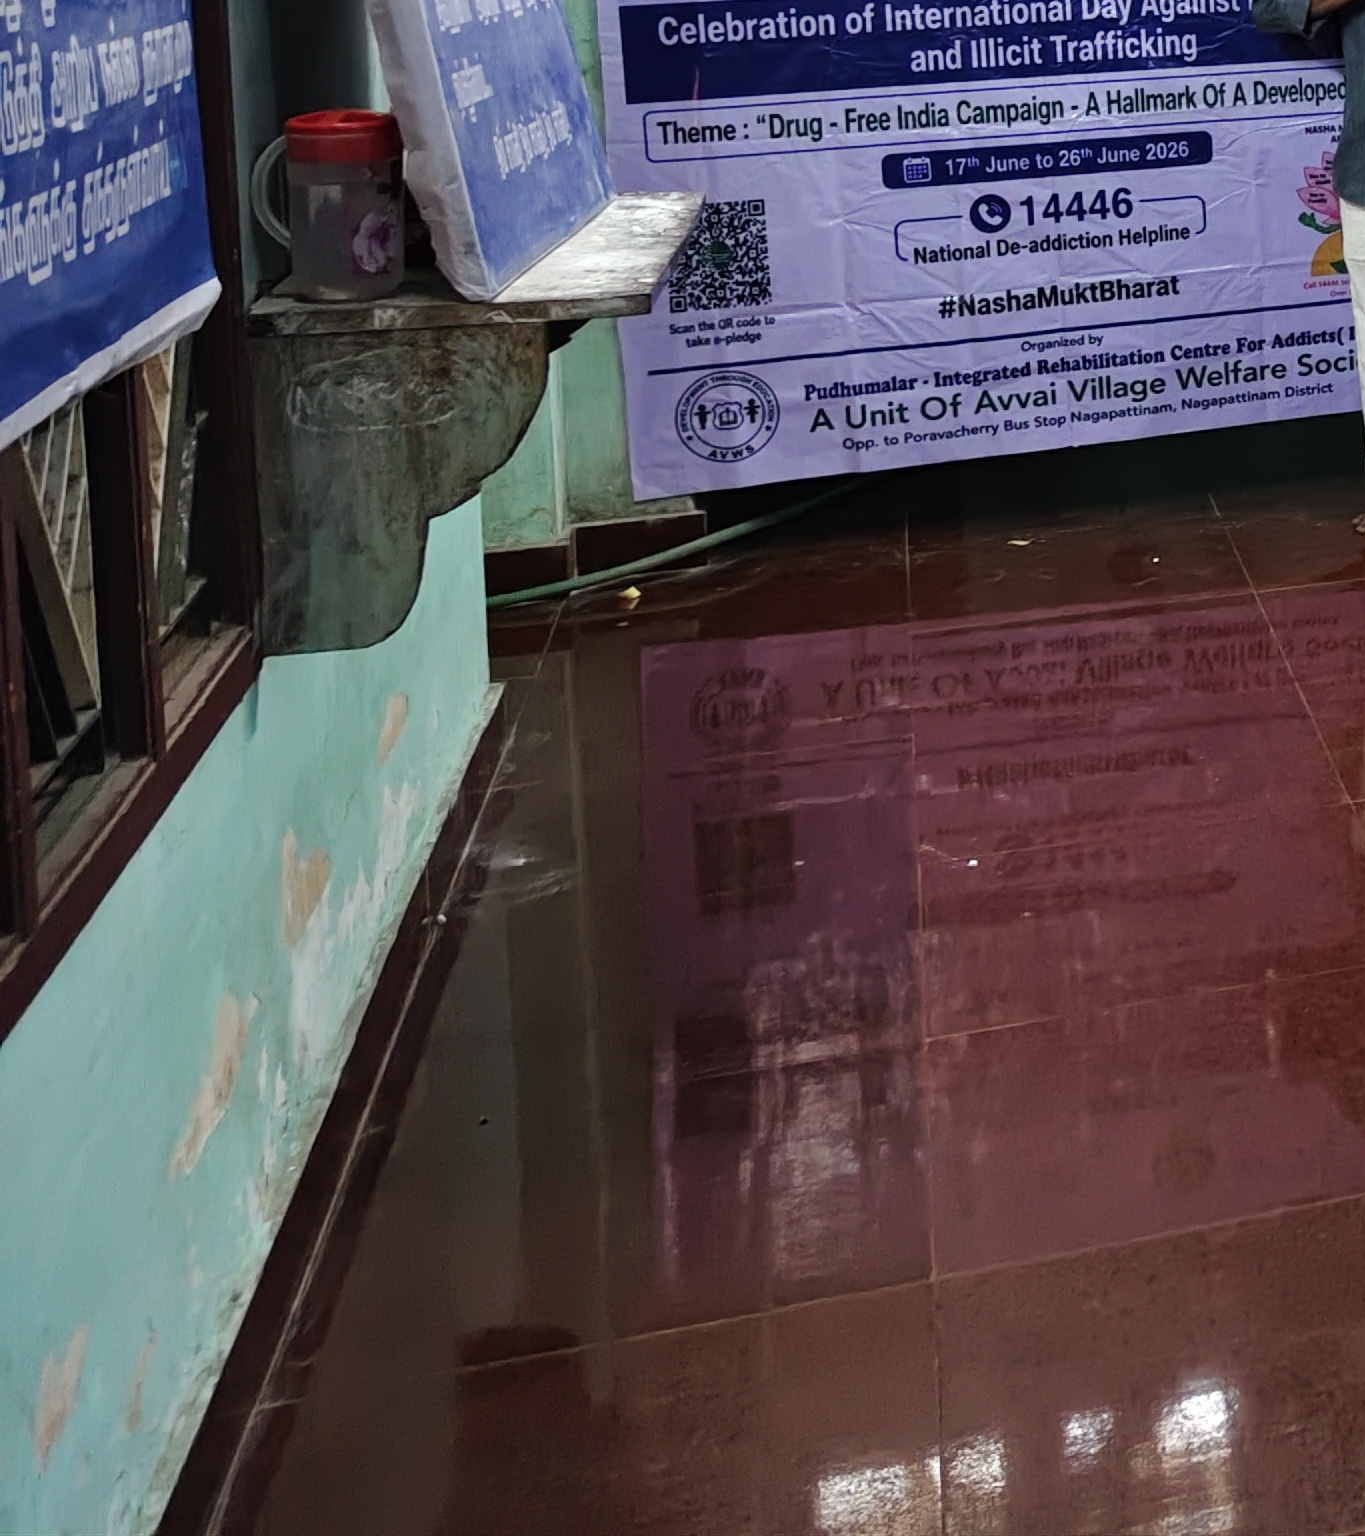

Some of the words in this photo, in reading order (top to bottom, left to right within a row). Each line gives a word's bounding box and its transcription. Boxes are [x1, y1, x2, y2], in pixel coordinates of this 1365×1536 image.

[657, 7, 836, 46] Celebration
[845, 2, 875, 34] of
[910, 39, 962, 73] and
[971, 35, 1042, 69] Illicit
[1050, 28, 1198, 64] Trafficking
[656, 119, 737, 145] Theme
[844, 107, 891, 134] Free
[897, 102, 949, 131] India
[956, 94, 1065, 128] Campaign
[1085, 92, 1101, 117] A
[1107, 85, 1197, 116] Hallmark
[1203, 82, 1227, 107] Of
[1232, 82, 1247, 106] A
[1304, 125, 1336, 135] NASHA
[944, 154, 980, 177] 17th
[985, 152, 1030, 174] June
[1035, 150, 1054, 169] to
[1058, 147, 1093, 168] 26th
[1096, 143, 1141, 165] June
[1145, 140, 1190, 162] 2026
[1019, 187, 1134, 227] 14446
[912, 239, 991, 265] National
[996, 231, 1113, 258] De-addiction
[1118, 224, 1191, 248] Helpline
[938, 275, 1180, 319] #NashaMuktBharat
[669, 321, 696, 335] Scan
[698, 319, 716, 333] the
[718, 318, 735, 332] QR
[737, 316, 761, 329] code
[764, 314, 776, 326] to
[685, 334, 711, 349] take
[714, 330, 762, 346] e-pledge
[1021, 335, 1085, 353] Organized
[1088, 333, 1104, 347] by
[803, 375, 919, 401] Pudhumalar
[933, 362, 1031, 389] Integrated
[1037, 348, 1165, 375] Rehabilitation
[1170, 342, 1231, 361] Centre
[1235, 336, 1267, 354] For
[809, 407, 835, 433] A
[845, 401, 910, 429] Unit
[920, 392, 963, 421] Of
[974, 382, 1057, 414] Avvai
[1067, 375, 1167, 403] Village
[1175, 360, 1288, 391] Welfare
[1297, 349, 1359, 377] Soci
[842, 437, 879, 453] Opp.
[884, 434, 900, 446] to
[903, 423, 1000, 444] Poravacherry
[1003, 419, 1030, 432] Bus
[1034, 414, 1067, 432] Stop
[1070, 402, 1178, 425] Nagapattinam,
[1181, 389, 1281, 410] Nagapattinam
[1284, 382, 1335, 399] District
[707, 444, 755, 460] AVWS
